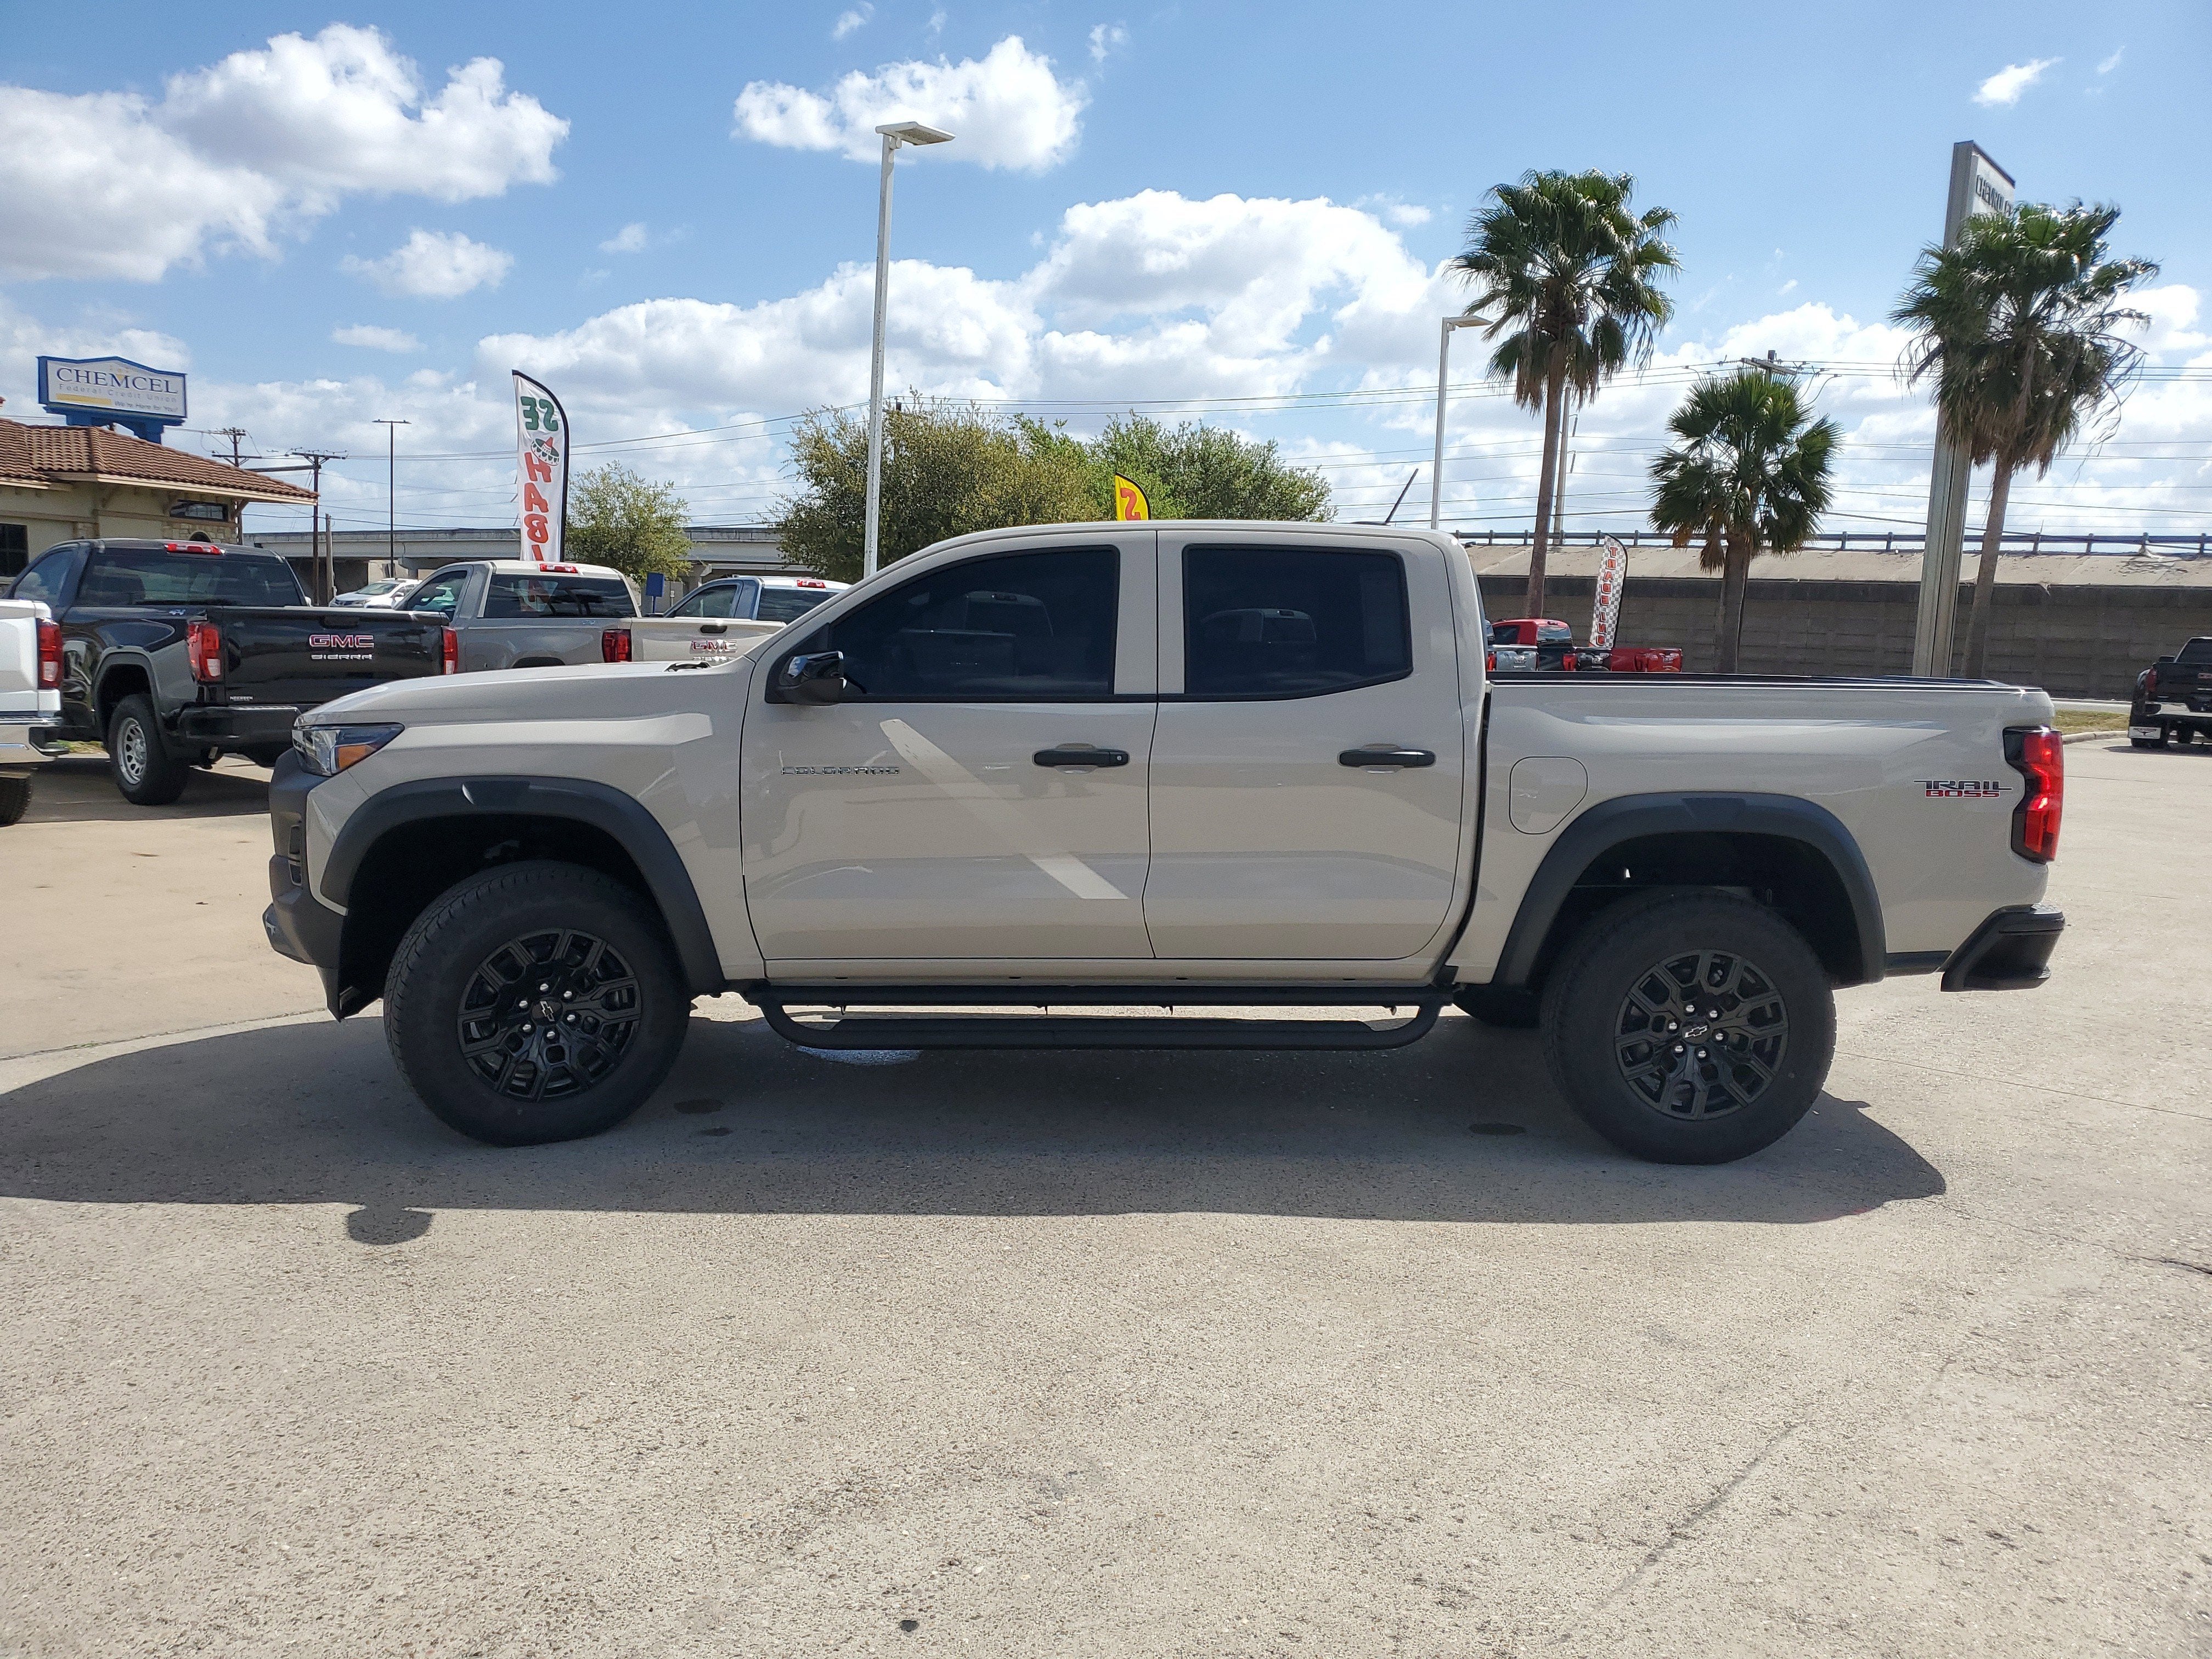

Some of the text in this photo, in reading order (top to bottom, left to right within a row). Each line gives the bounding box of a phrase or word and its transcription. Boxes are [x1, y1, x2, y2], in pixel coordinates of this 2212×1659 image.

[57, 367, 178, 394] CHEMCEL
[59, 383, 177, 403] Federal Credit Union
[309, 634, 375, 648] GMC
[691, 640, 737, 653] GMC
[781, 766, 900, 775] COLORADO
[1914, 780, 2013, 791] TRAIL
[1926, 789, 2000, 798] BOSS
